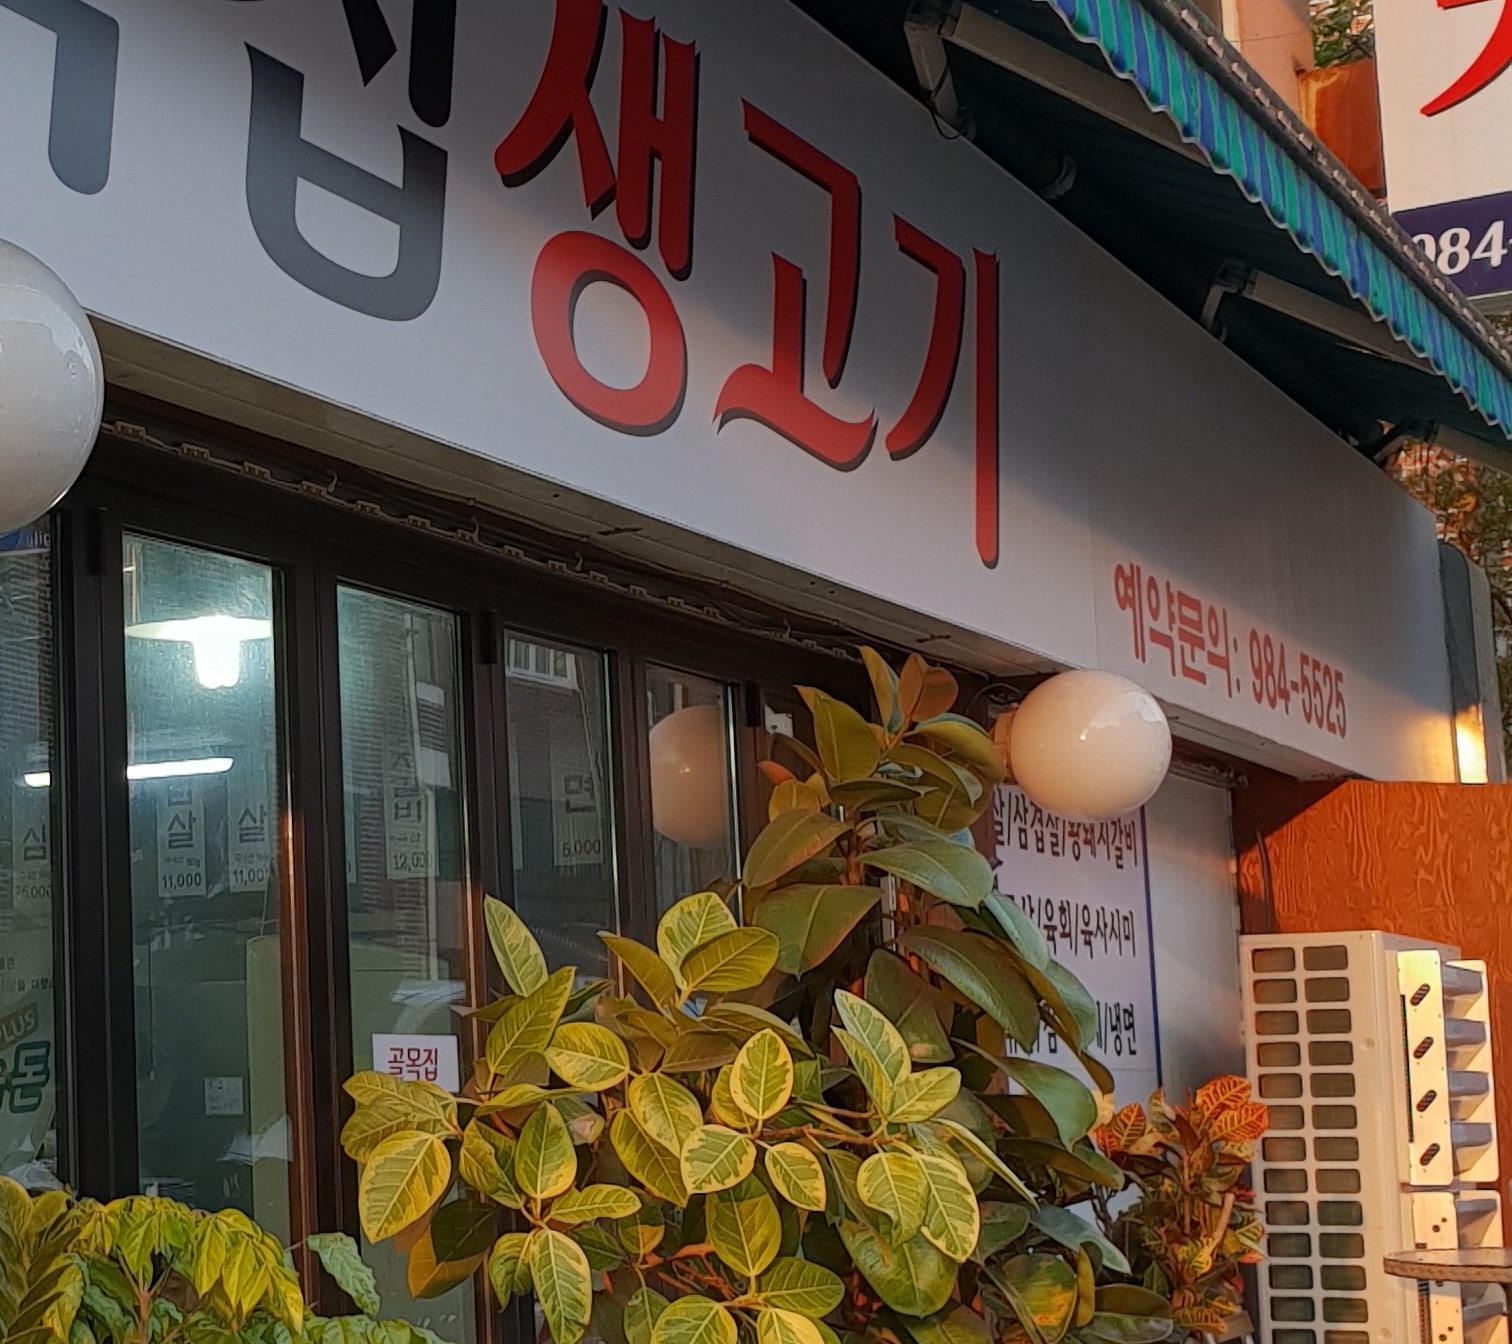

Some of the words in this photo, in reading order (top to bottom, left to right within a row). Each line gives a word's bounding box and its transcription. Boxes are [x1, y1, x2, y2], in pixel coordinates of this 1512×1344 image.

[1249, 628, 1348, 739] 984-5525
[162, 872, 202, 890] 11,000
[387, 1047, 438, 1082] 골목집
